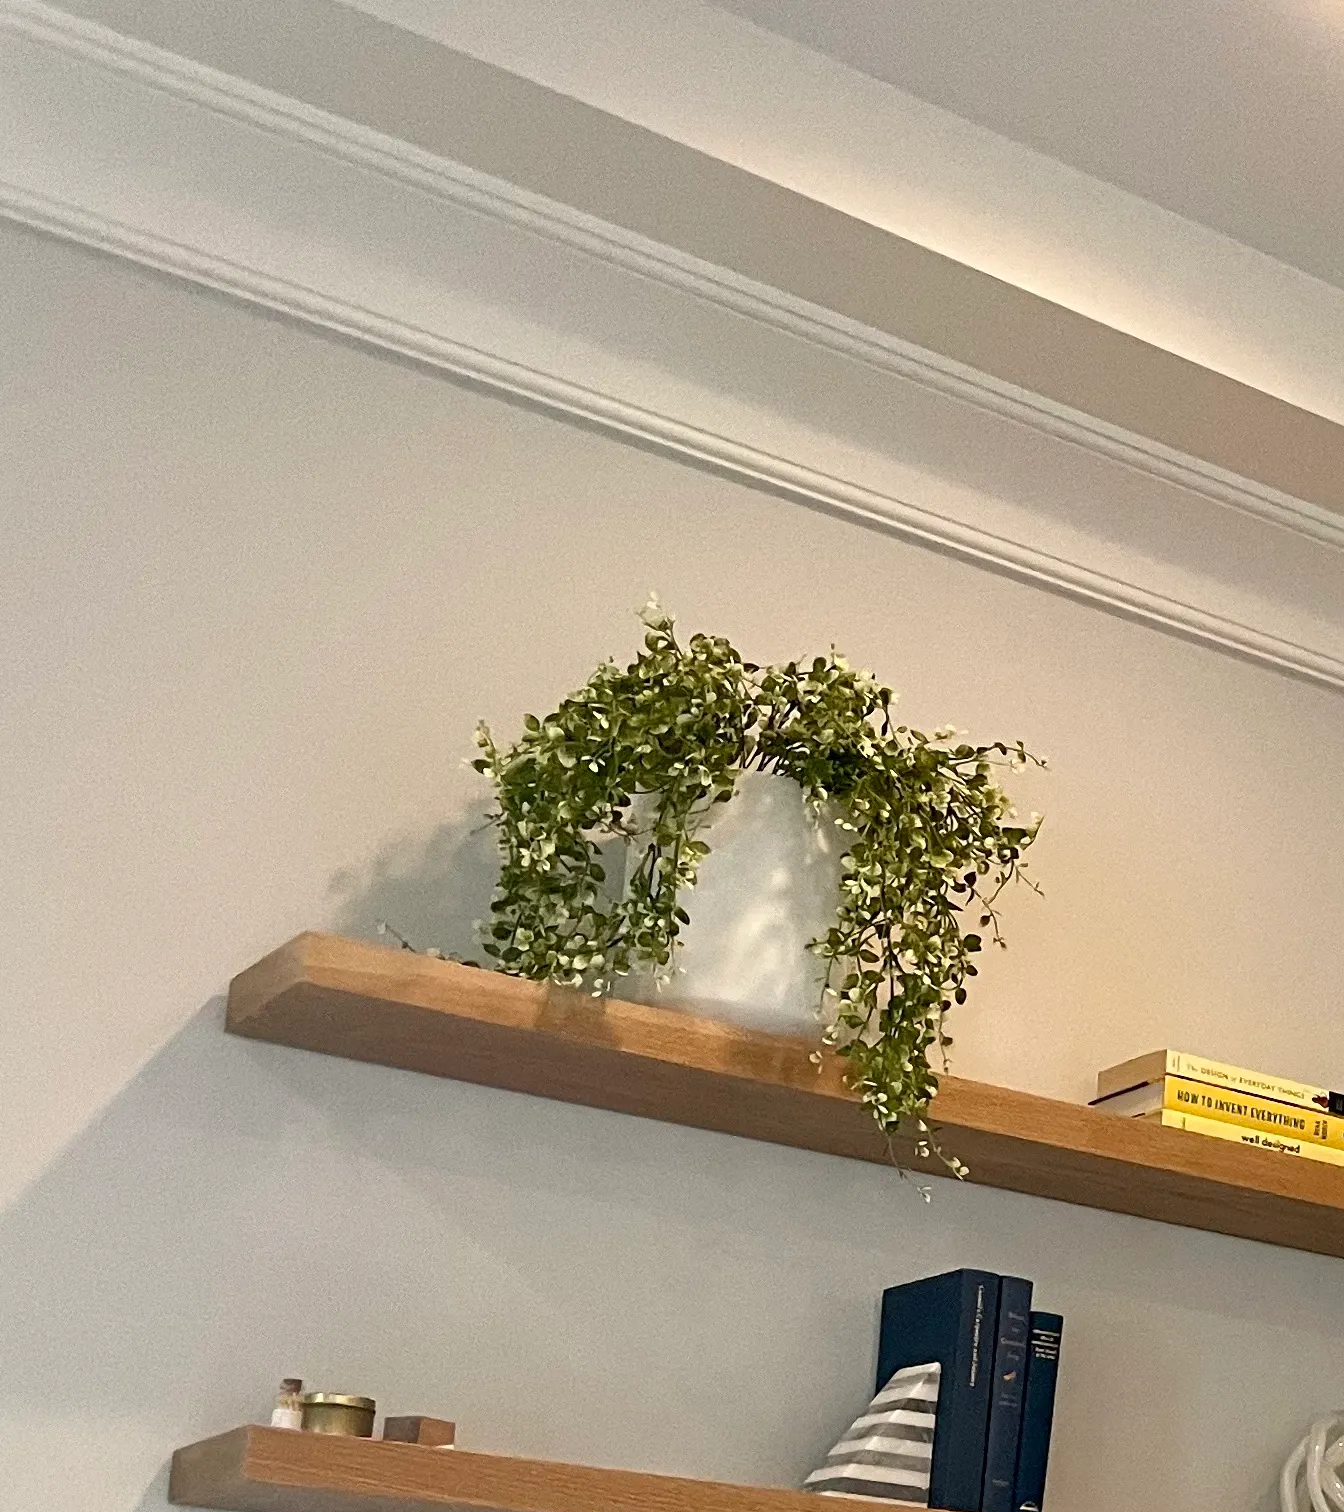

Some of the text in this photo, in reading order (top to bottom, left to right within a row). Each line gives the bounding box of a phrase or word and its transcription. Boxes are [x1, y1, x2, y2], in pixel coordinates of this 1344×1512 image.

[1200, 1067, 1228, 1080] DESIGN
[1239, 1077, 1276, 1092] EVERYDAY
[1177, 1089, 1199, 1105] HOW
[1202, 1095, 1212, 1108] TO
[1215, 1099, 1248, 1116] INVENT
[1251, 1107, 1305, 1130] EVERYTHING
[1241, 1134, 1300, 1153] well designed
